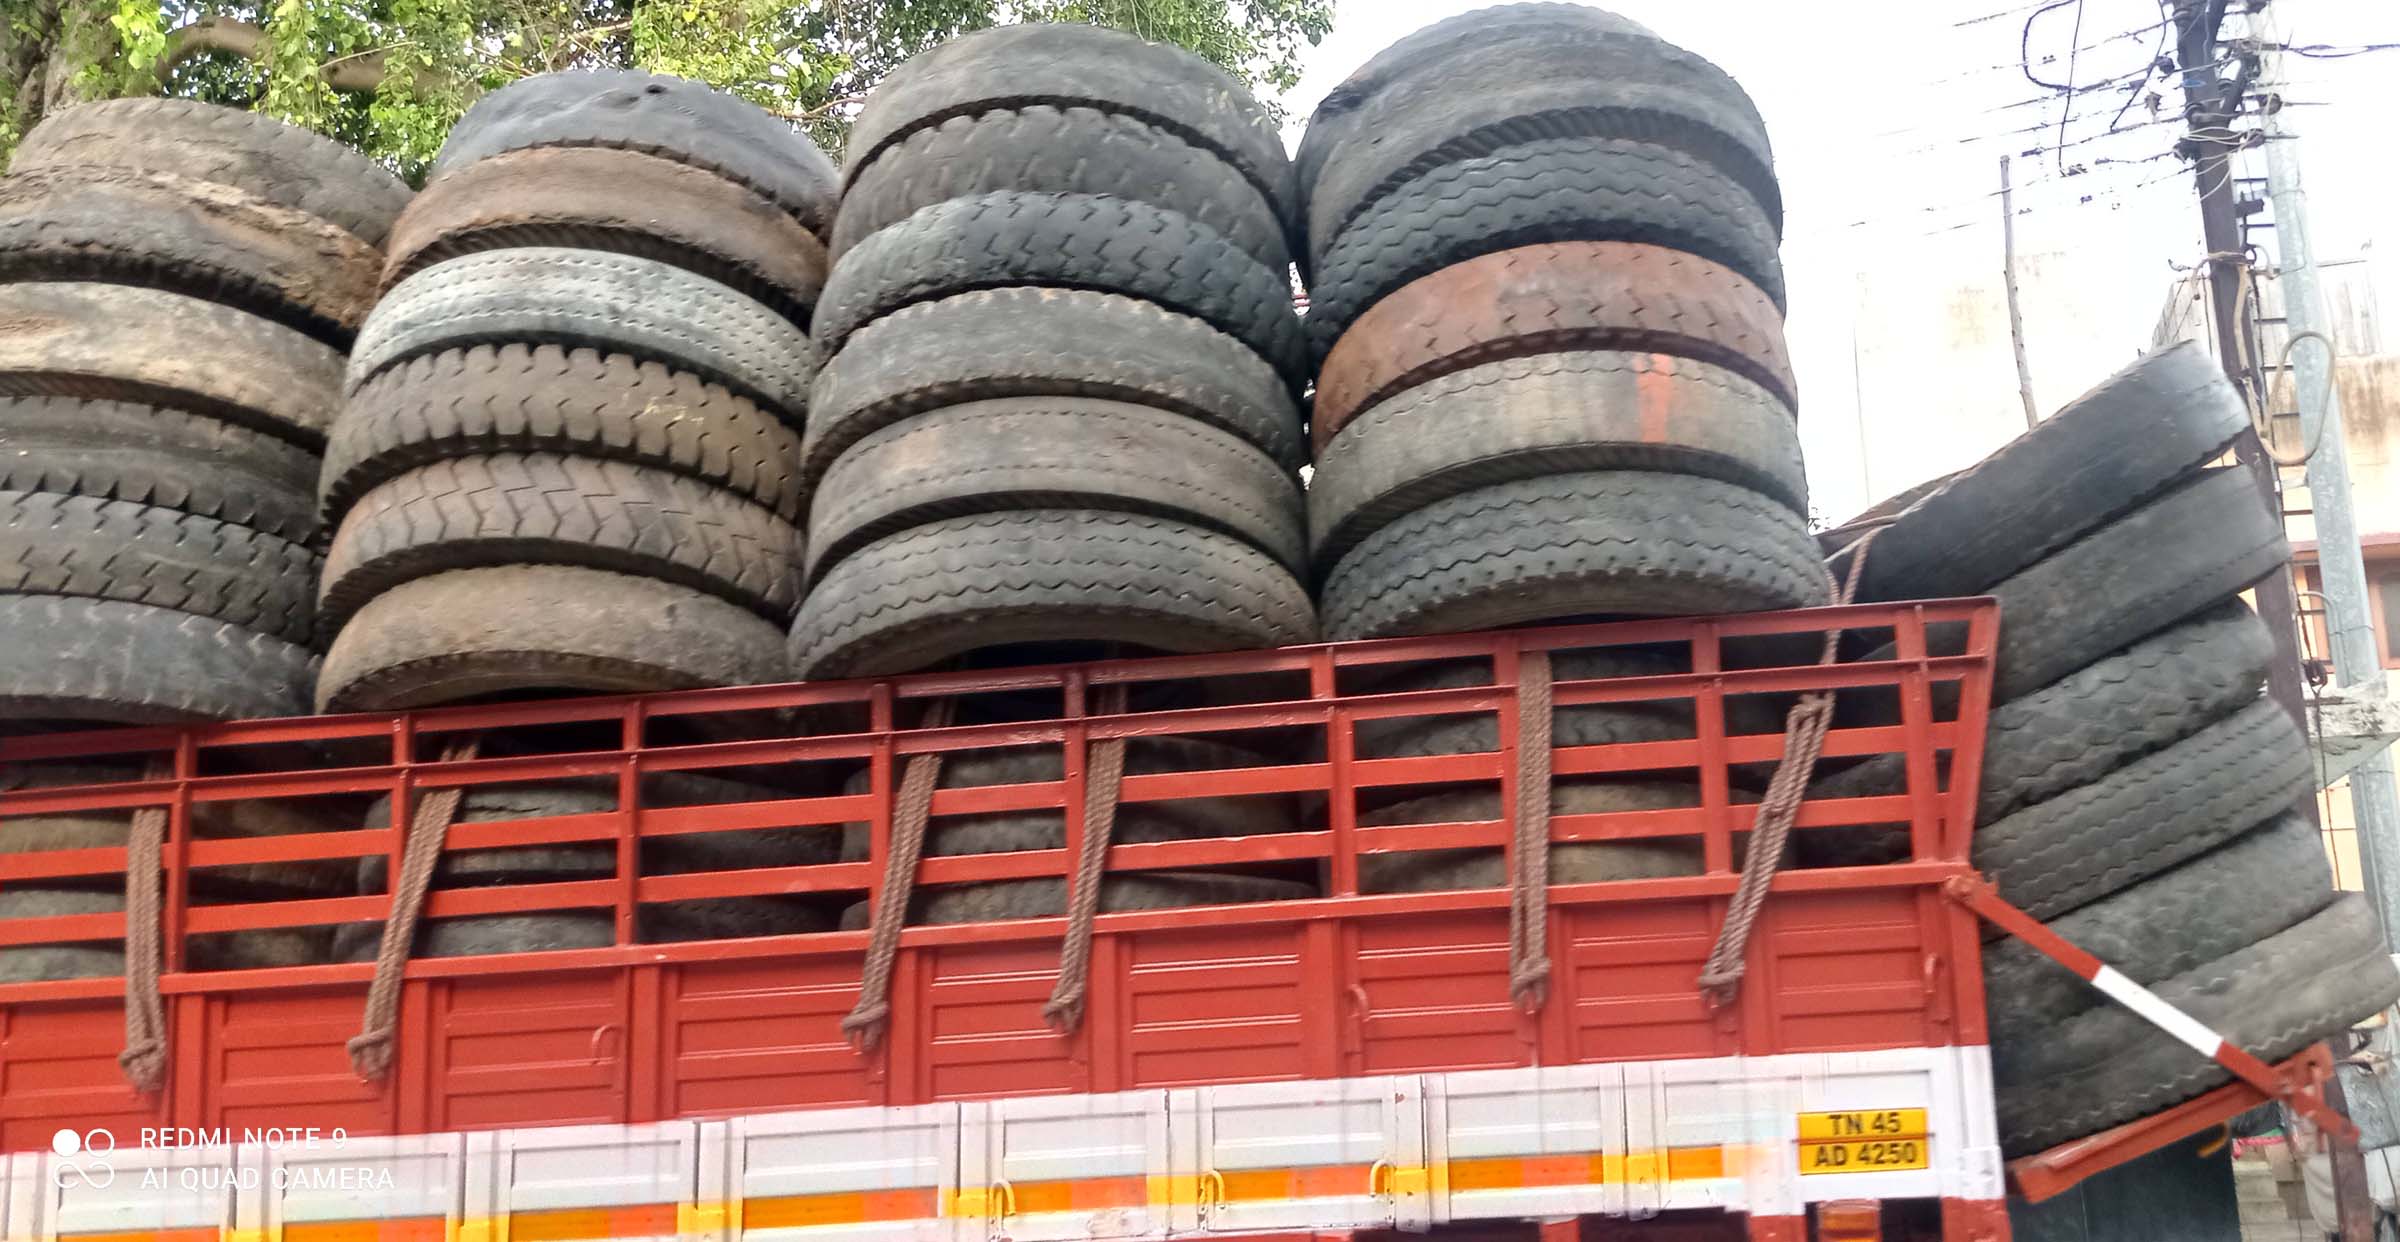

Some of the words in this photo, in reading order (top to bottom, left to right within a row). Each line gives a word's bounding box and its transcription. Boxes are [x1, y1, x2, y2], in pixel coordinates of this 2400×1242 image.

[1828, 1114, 1863, 1135] TN
[1872, 1112, 1901, 1133] 45
[1815, 1145, 1848, 1166] AD
[1857, 1142, 1918, 1165] 4250
